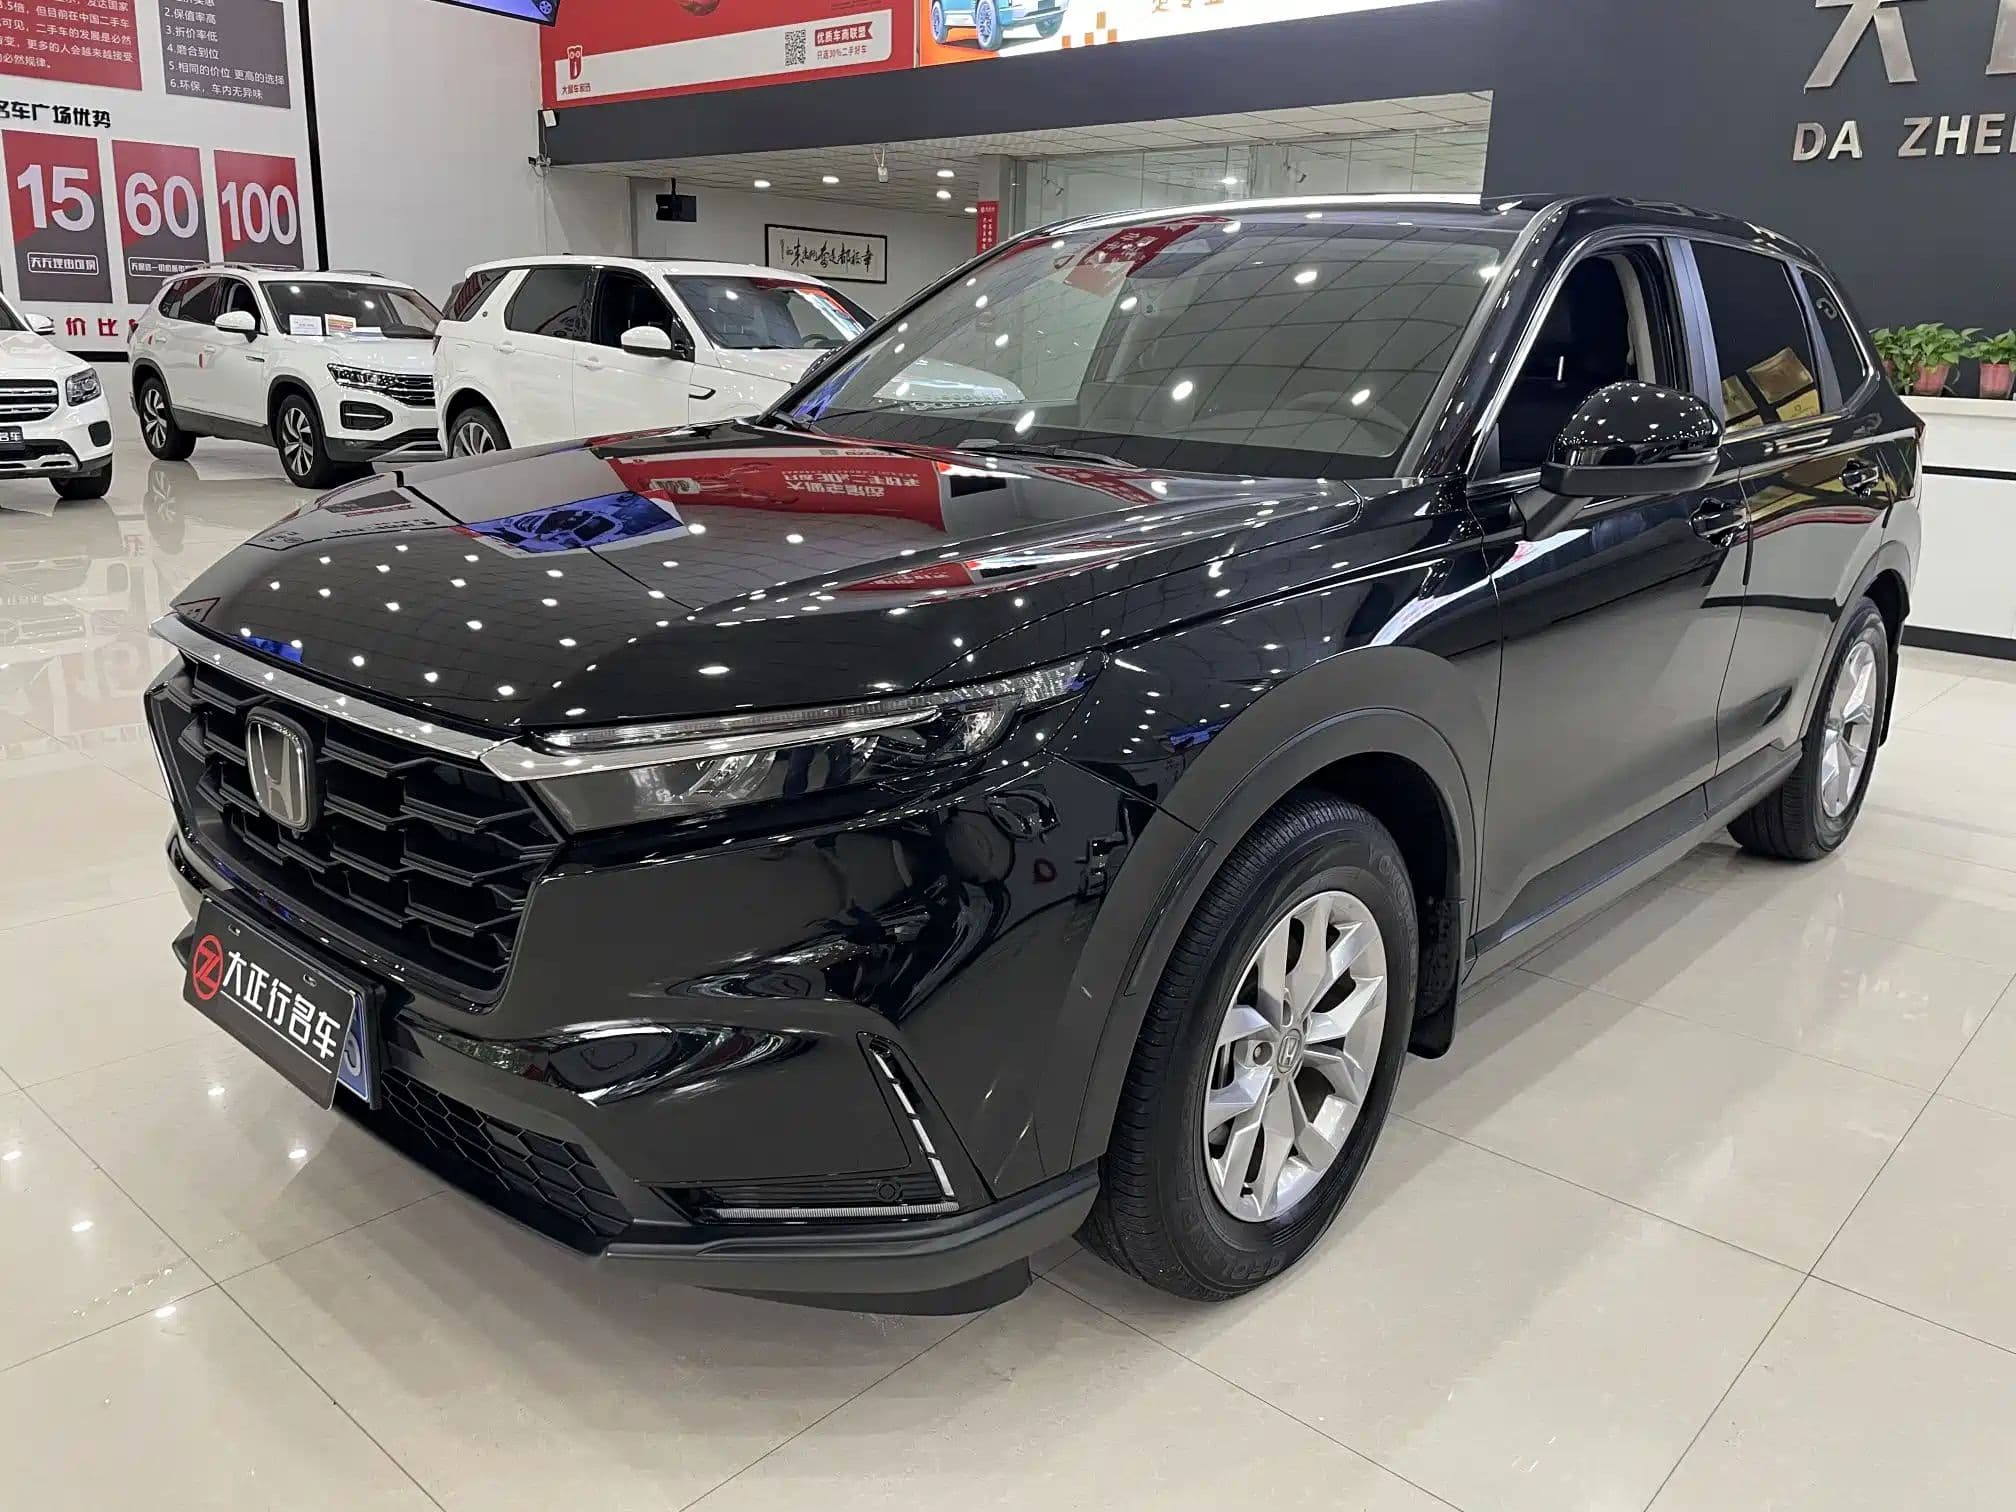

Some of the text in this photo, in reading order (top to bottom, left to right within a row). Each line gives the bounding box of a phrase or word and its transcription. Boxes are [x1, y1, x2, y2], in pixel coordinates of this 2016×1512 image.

[57, 0, 129, 12] ，发达国家
[164, 7, 216, 25] 2.保值率高
[0, 18, 132, 45] 可见，二手车的发展是必然
[165, 25, 218, 42] 3.折价率低
[816, 25, 867, 45] 优质车商联盟
[0, 53, 51, 68] 必然规律。
[167, 43, 220, 60] 4.磨合到位
[168, 61, 285, 85] 5.相同的价位 更高的选择
[170, 79, 263, 99] 6.环保，车内无异味
[1792, 113, 2016, 161] DA ZHE
[17, 164, 95, 232] 15
[124, 172, 199, 238] 60
[221, 181, 297, 245] 100
[222, 951, 341, 1059] 大正行名车
